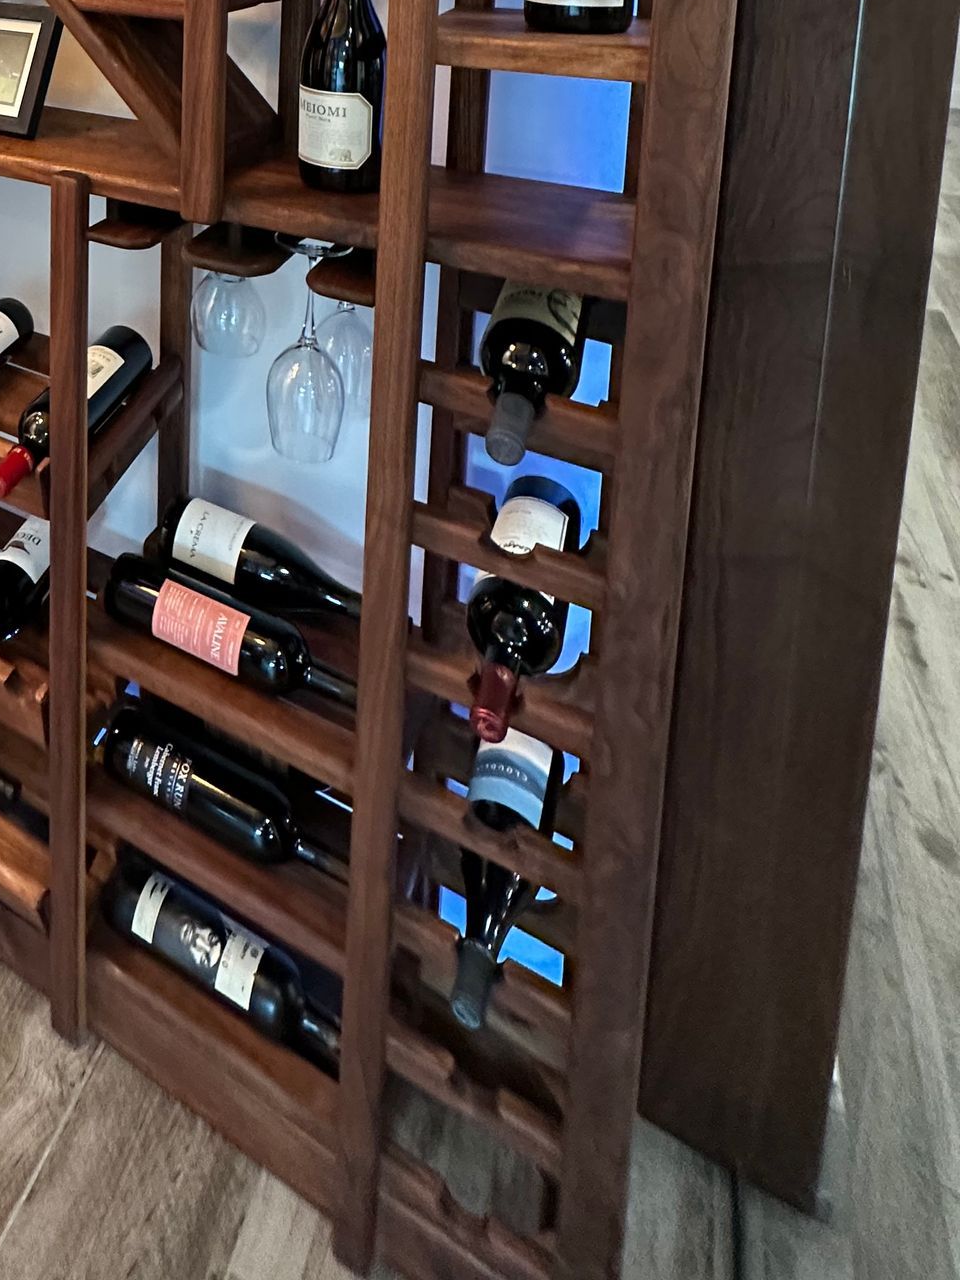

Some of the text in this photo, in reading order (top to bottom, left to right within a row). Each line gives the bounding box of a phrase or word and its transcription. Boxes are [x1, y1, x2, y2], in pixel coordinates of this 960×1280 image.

[17, 531, 42, 547] DEC
[190, 511, 210, 558] LA CREMA
[209, 612, 229, 661] AVALINE
[146, 745, 164, 787] Lemberger
[153, 743, 174, 797] Cabernet Franc
[173, 758, 193, 810] FOX RUN
